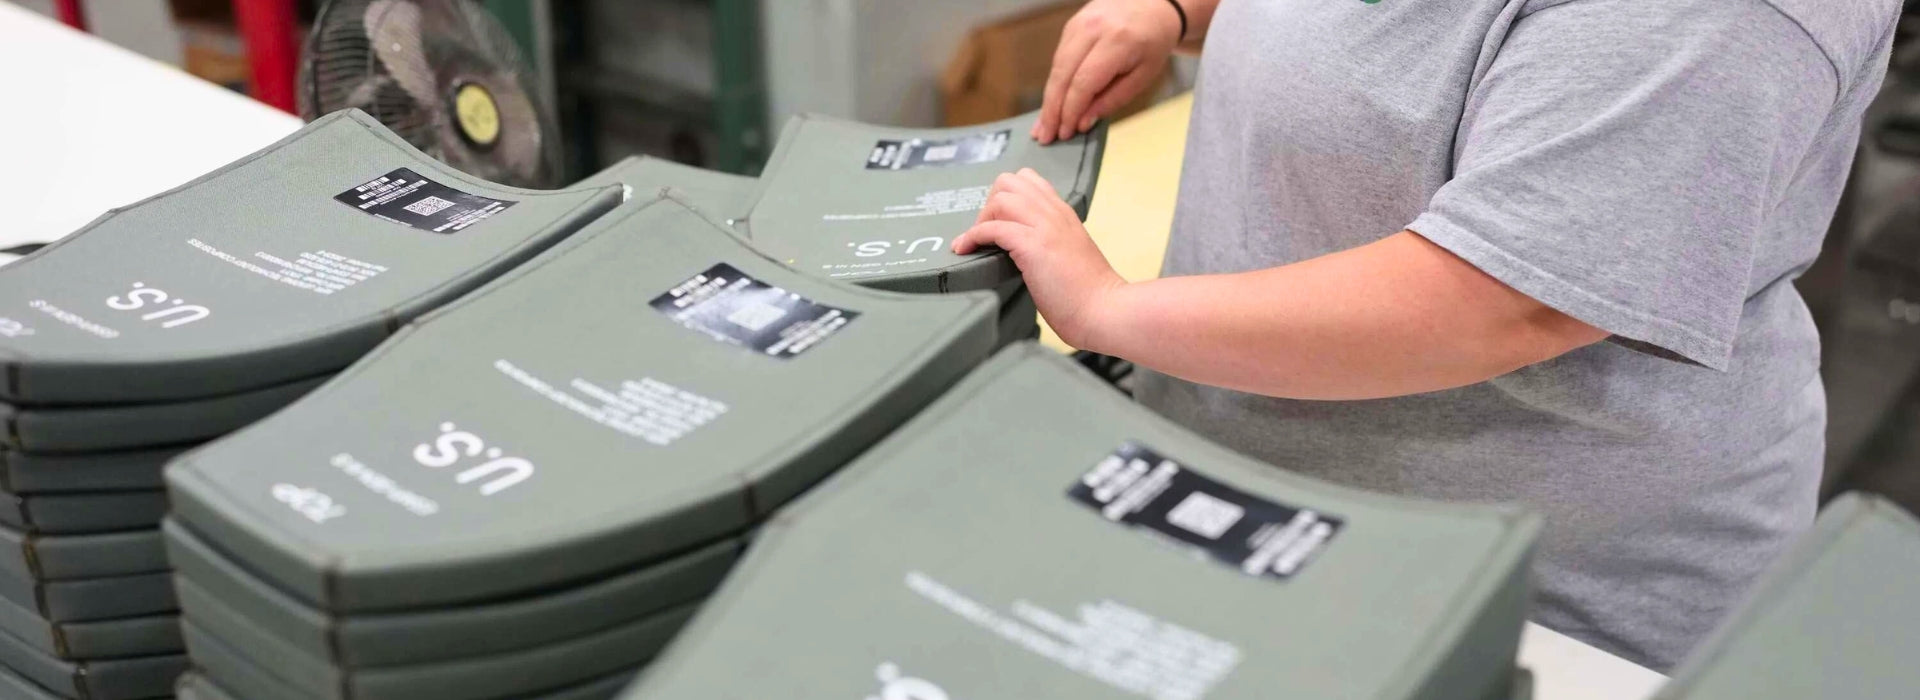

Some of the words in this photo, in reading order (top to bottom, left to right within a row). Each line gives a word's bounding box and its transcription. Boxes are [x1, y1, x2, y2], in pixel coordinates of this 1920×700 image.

[847, 236, 944, 257] U.S.
[106, 281, 211, 330] U.S.
[413, 421, 534, 496] U.S.
